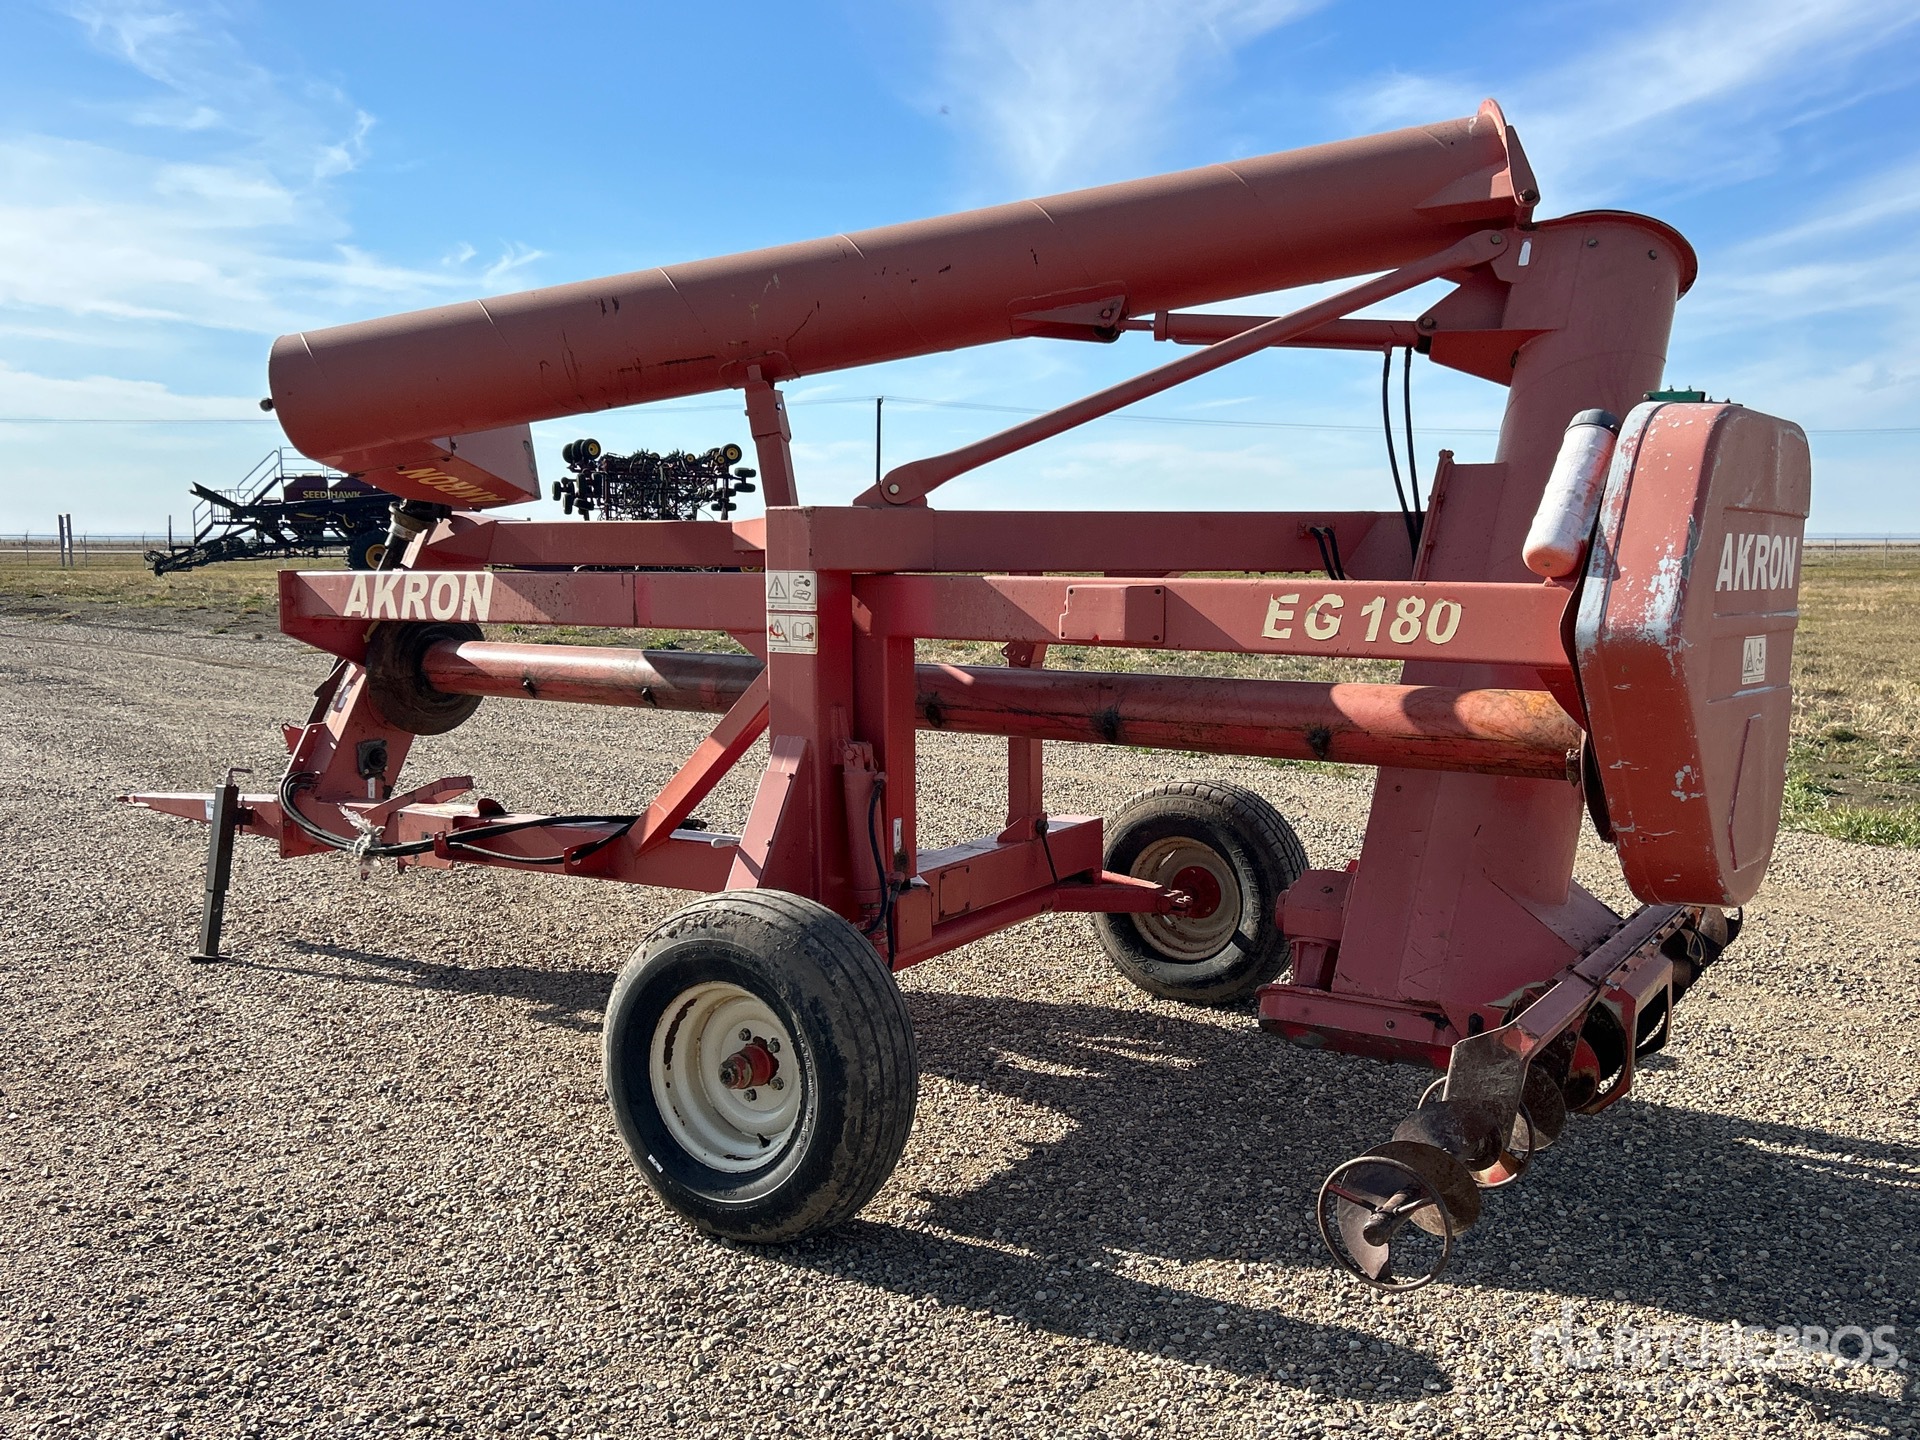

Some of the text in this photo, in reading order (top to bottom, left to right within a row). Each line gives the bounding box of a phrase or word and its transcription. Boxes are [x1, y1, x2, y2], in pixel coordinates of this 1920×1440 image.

[303, 490, 361, 499] SEED HAWK
[396, 468, 507, 503] AKRON
[1715, 533, 1797, 592] AKRON
[343, 573, 494, 621] AKRON
[1261, 594, 1462, 644] EG 180
